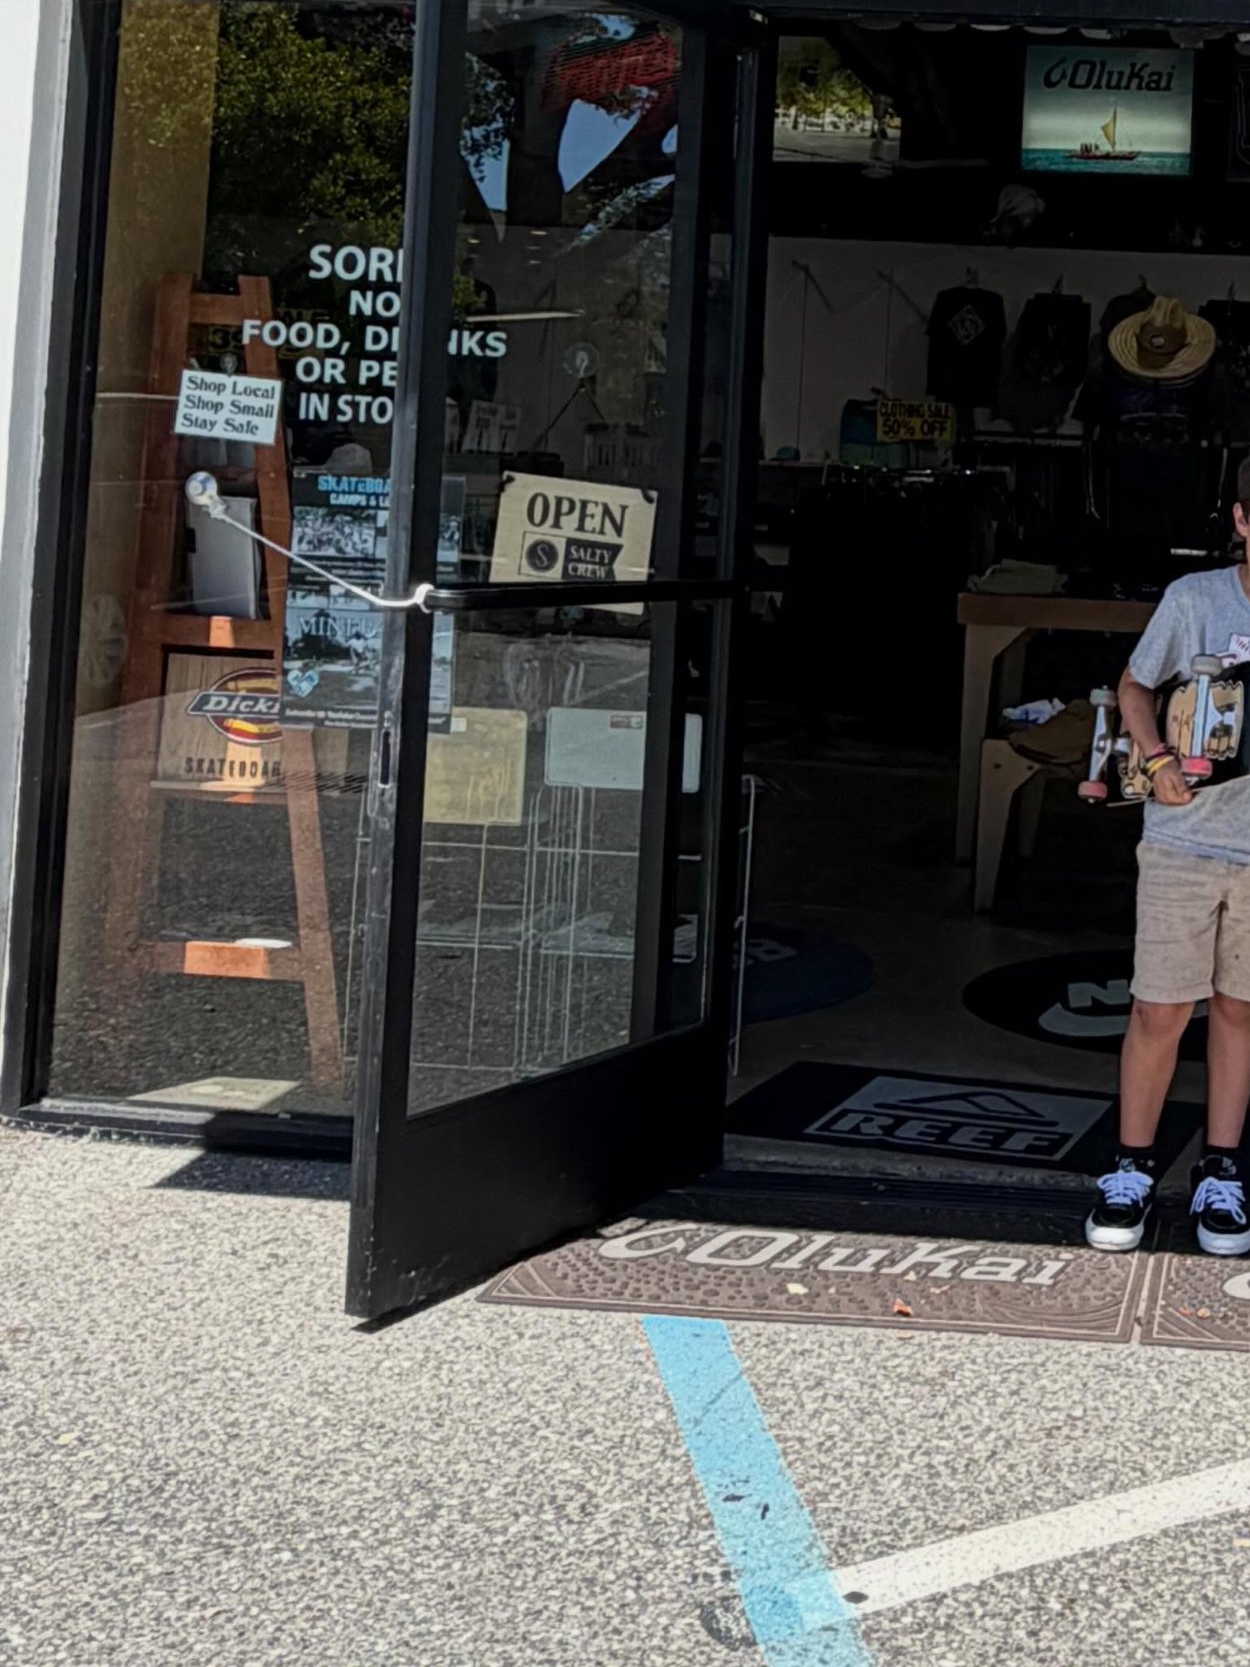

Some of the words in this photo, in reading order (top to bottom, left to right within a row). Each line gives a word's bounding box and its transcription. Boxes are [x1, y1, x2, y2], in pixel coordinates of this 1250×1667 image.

[1066, 57, 1177, 93] OluKai
[308, 244, 403, 283] SOR
[349, 290, 401, 318] NO
[242, 319, 351, 355] FOOD,
[364, 325, 508, 358] DKS
[295, 357, 347, 384] OR
[358, 361, 399, 387] PE
[186, 375, 227, 396] Shop
[231, 381, 276, 400] Local
[184, 394, 224, 415] Shop
[229, 400, 275, 419] Small
[299, 392, 330, 422] IN
[336, 395, 395, 425] STO
[180, 413, 218, 433] Stay
[222, 418, 259, 436] Safe
[317, 474, 391, 495] SKATEBOA
[526, 491, 630, 539] OPEN
[569, 544, 613, 565] SALTY
[567, 561, 610, 580] CREW
[203, 694, 280, 714] Dicki
[827, 1111, 1066, 1155] REEF
[685, 1230, 1076, 1286] OluKai
